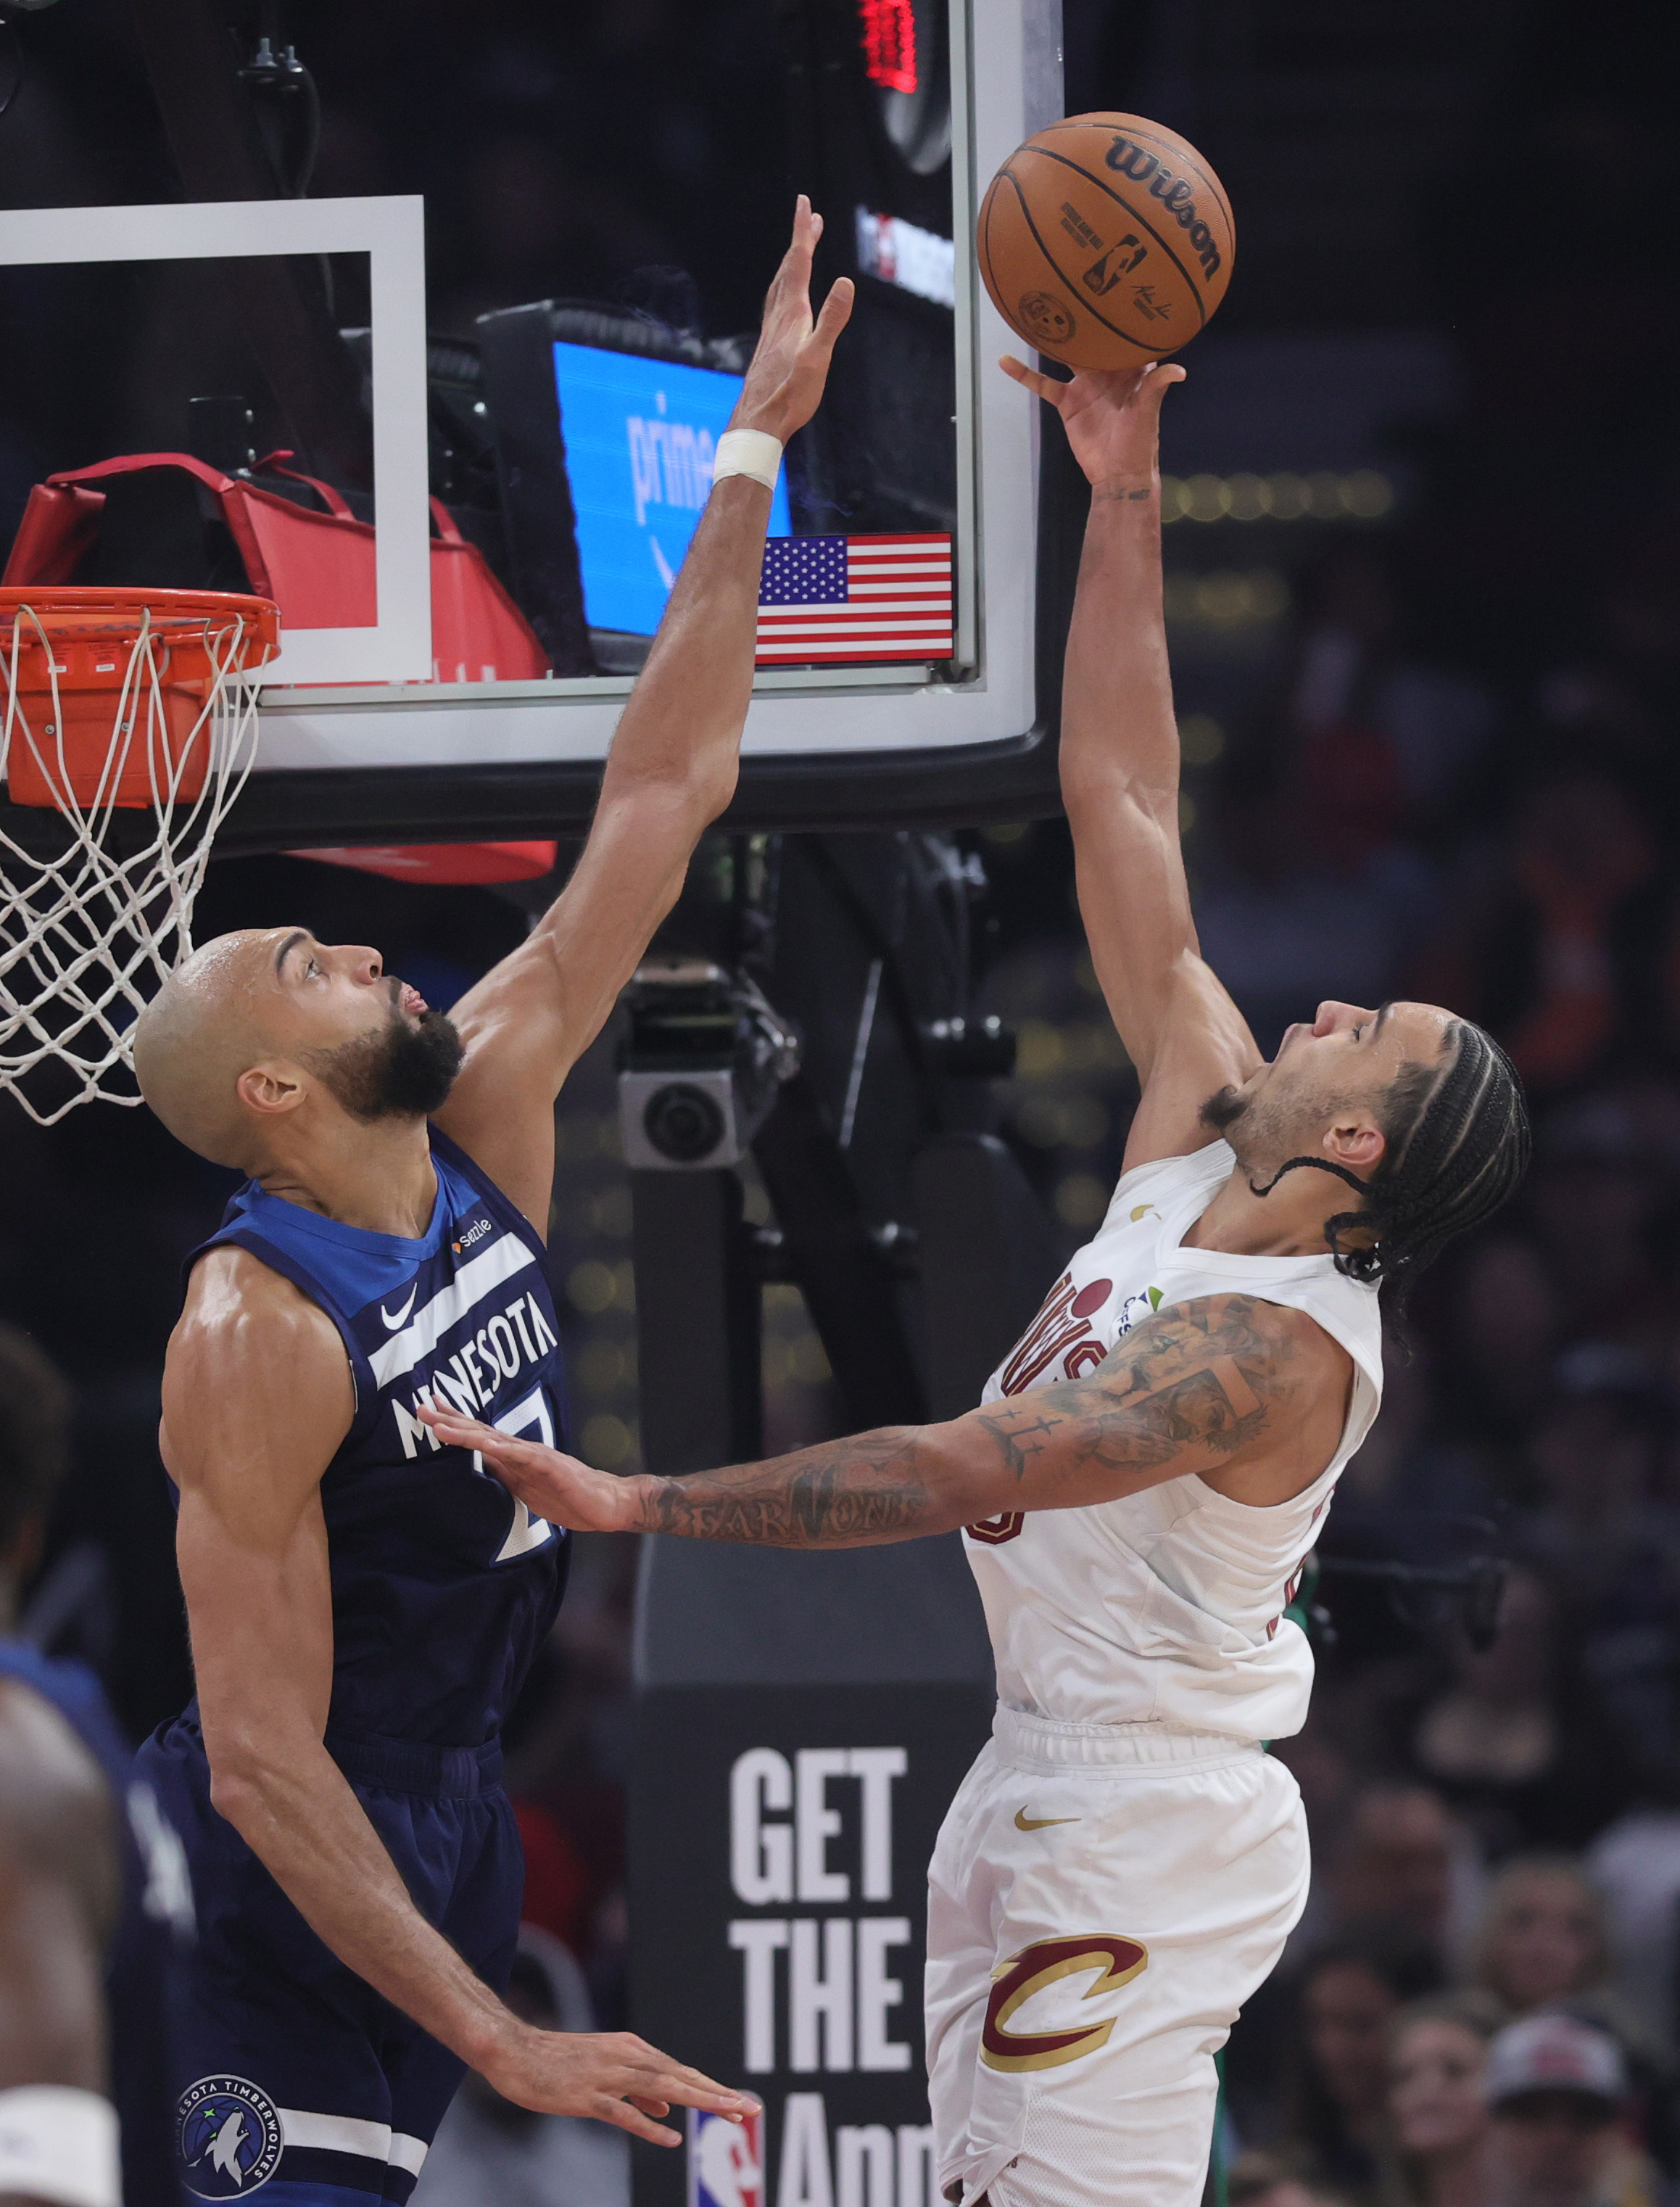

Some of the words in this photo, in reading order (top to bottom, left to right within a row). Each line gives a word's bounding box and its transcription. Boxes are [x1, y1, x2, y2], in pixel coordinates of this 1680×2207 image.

[1105, 136, 1221, 283] Wilson
[459, 1219, 492, 1247] sezzle
[729, 1746, 908, 1905] GET
[728, 1916, 911, 2073] THE
[980, 1932, 1148, 2073] C
[224, 2081, 278, 2179] TIMBERWOLVES
